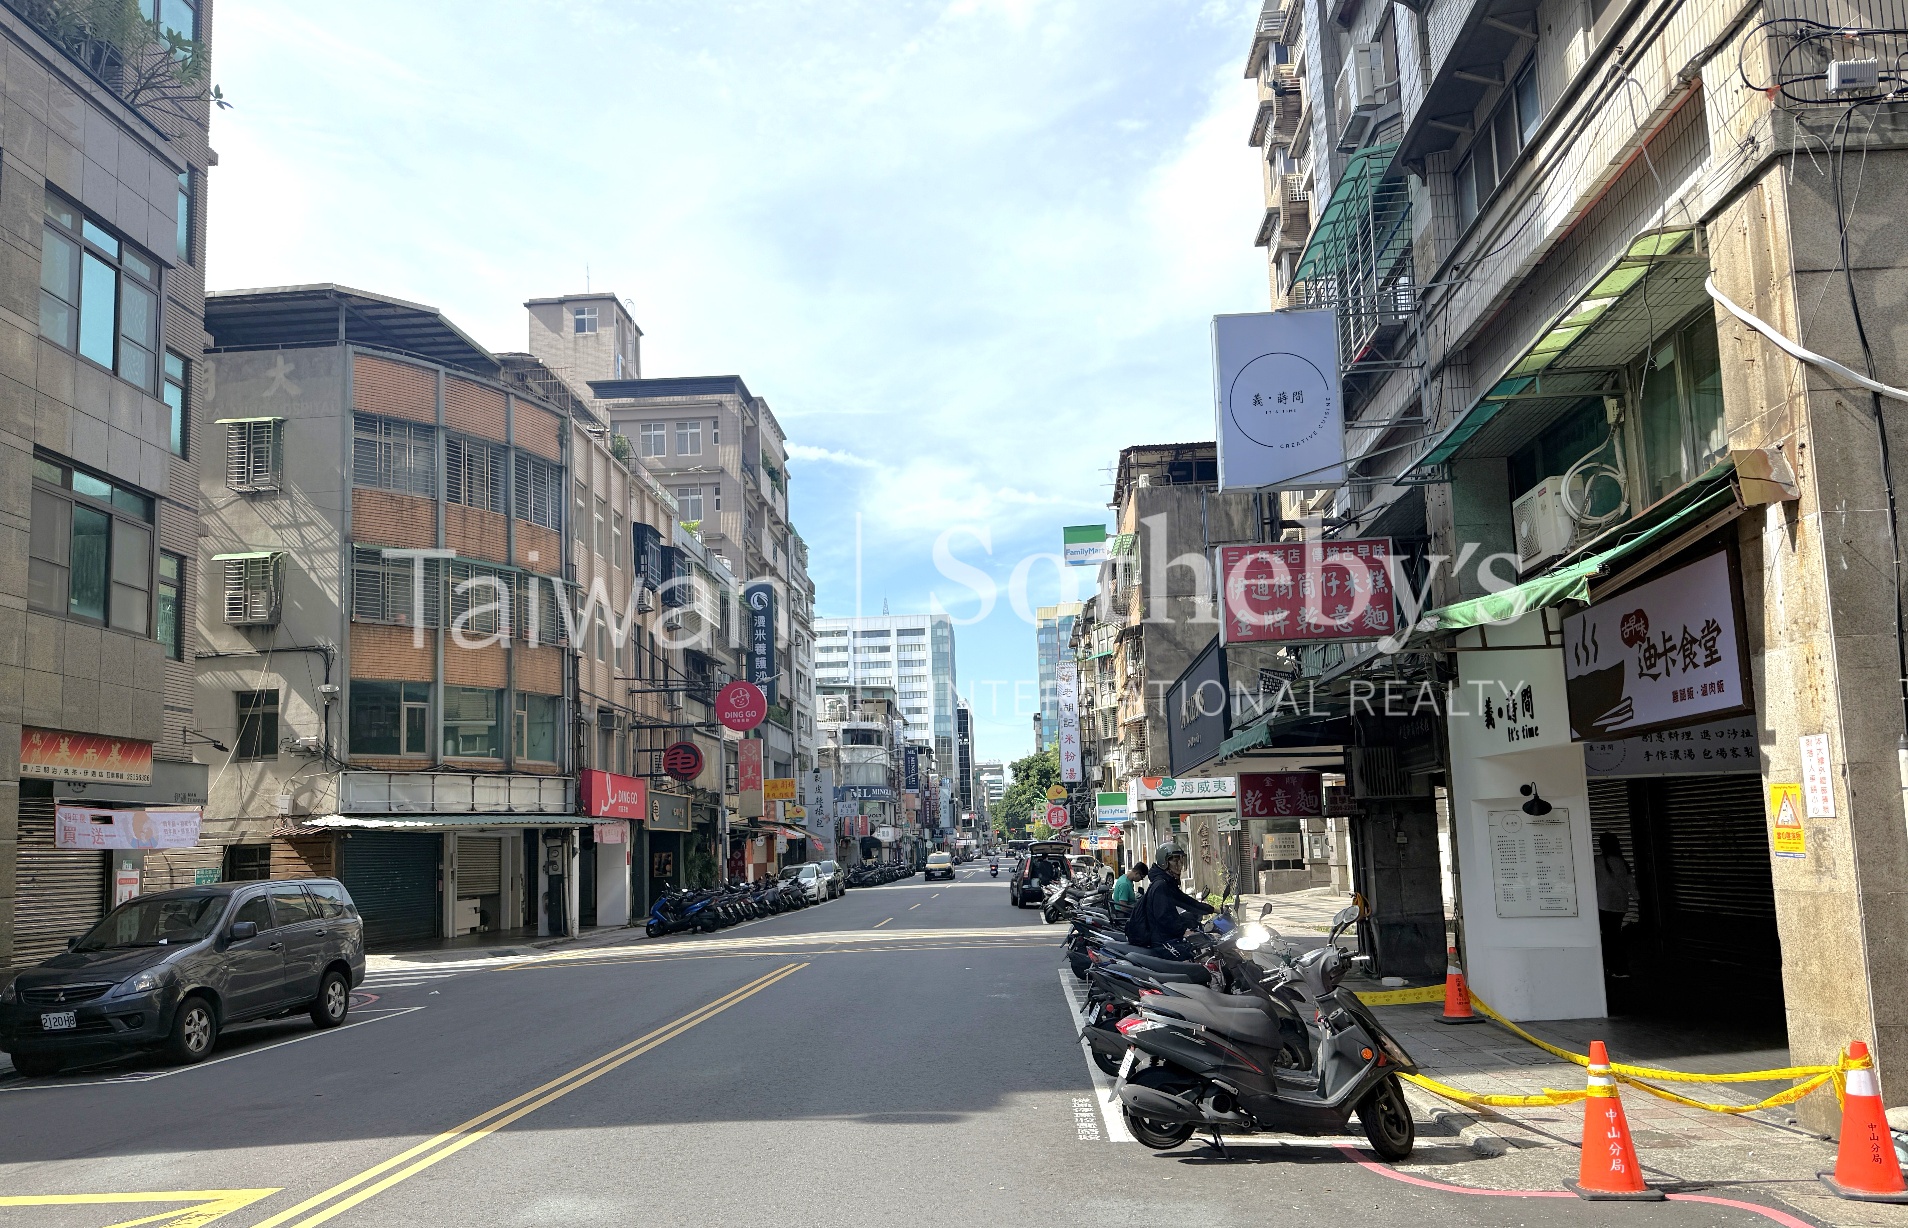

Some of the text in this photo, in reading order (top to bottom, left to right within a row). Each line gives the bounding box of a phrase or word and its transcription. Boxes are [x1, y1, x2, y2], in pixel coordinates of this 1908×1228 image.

[1279, 397, 1331, 449] CREATIVE CUISINE
[1065, 547, 1105, 557] FamilyMart
[1227, 544, 1386, 566] 三十年老店 傳統古早味
[1228, 568, 1390, 601] 伊通街筒仔米糕
[1231, 603, 1391, 637] 金牌乾意麵
[1621, 615, 1648, 639] 古早味
[1638, 618, 1722, 682] 迪卡食堂
[724, 710, 757, 719] DING GO
[1062, 687, 1077, 780] 老胡記米粉湯
[1507, 724, 1540, 743] It's time
[1700, 728, 1754, 741] 進口沙拉
[54, 736, 122, 769] 美而美
[1643, 746, 1755, 762] 手作濃湯 包場客製
[618, 789, 638, 805] DING GO
[1181, 779, 1228, 796] 海威夷
[1098, 808, 1127, 817] FamilyMart
[1243, 788, 1321, 816] 乾意麵
[62, 825, 117, 845] 買一送一
[1605, 1107, 1625, 1174] 中山分局
[1867, 1122, 1883, 1165] 中山分局
